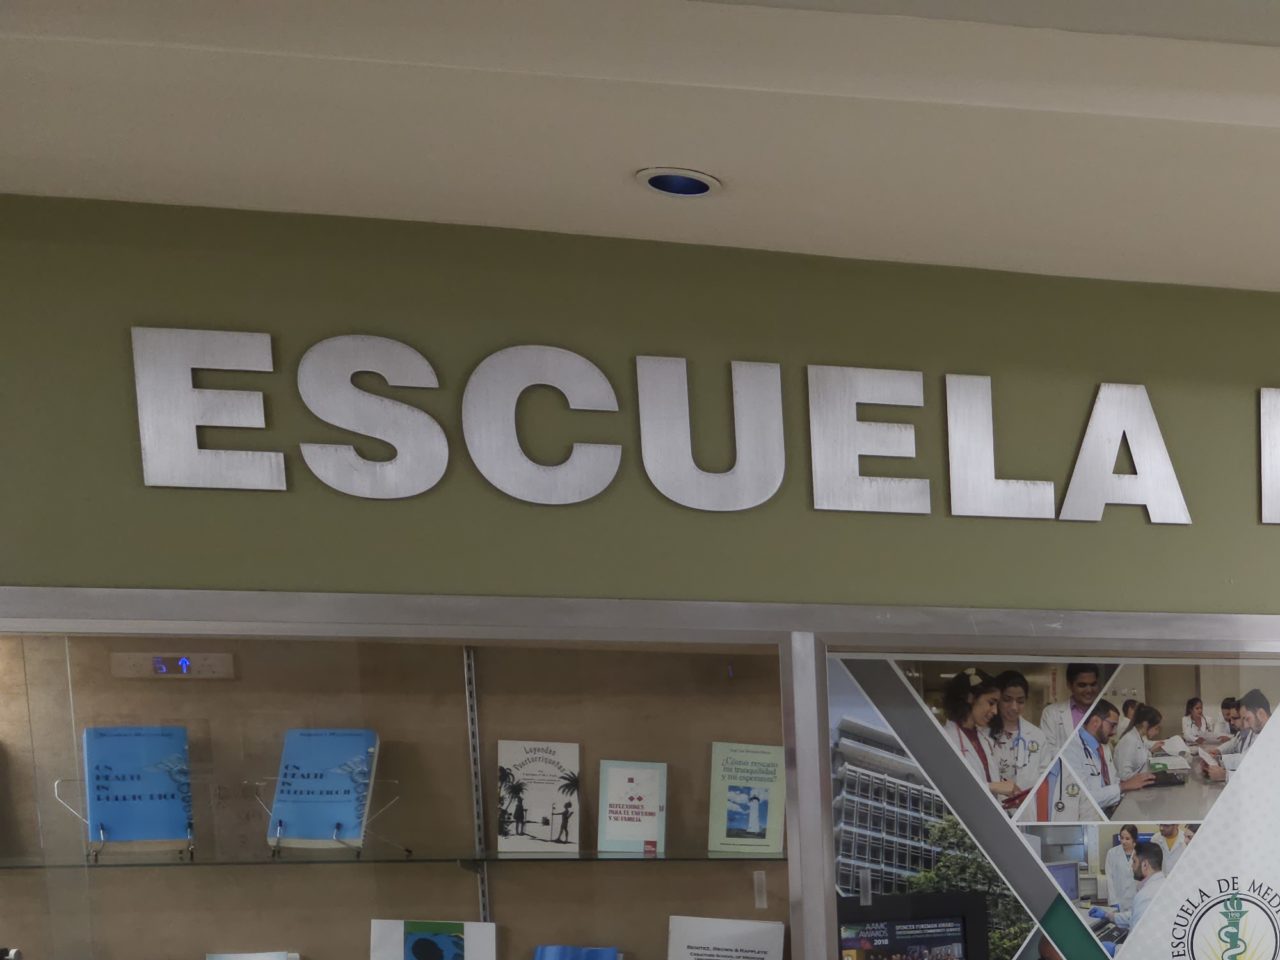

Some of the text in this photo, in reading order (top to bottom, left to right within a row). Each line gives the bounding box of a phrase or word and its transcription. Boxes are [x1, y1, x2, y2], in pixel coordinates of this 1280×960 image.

[130, 326, 1193, 513] ESCUELA
[1171, 888, 1212, 959] ESCUELA
[1217, 876, 1239, 893] DE
